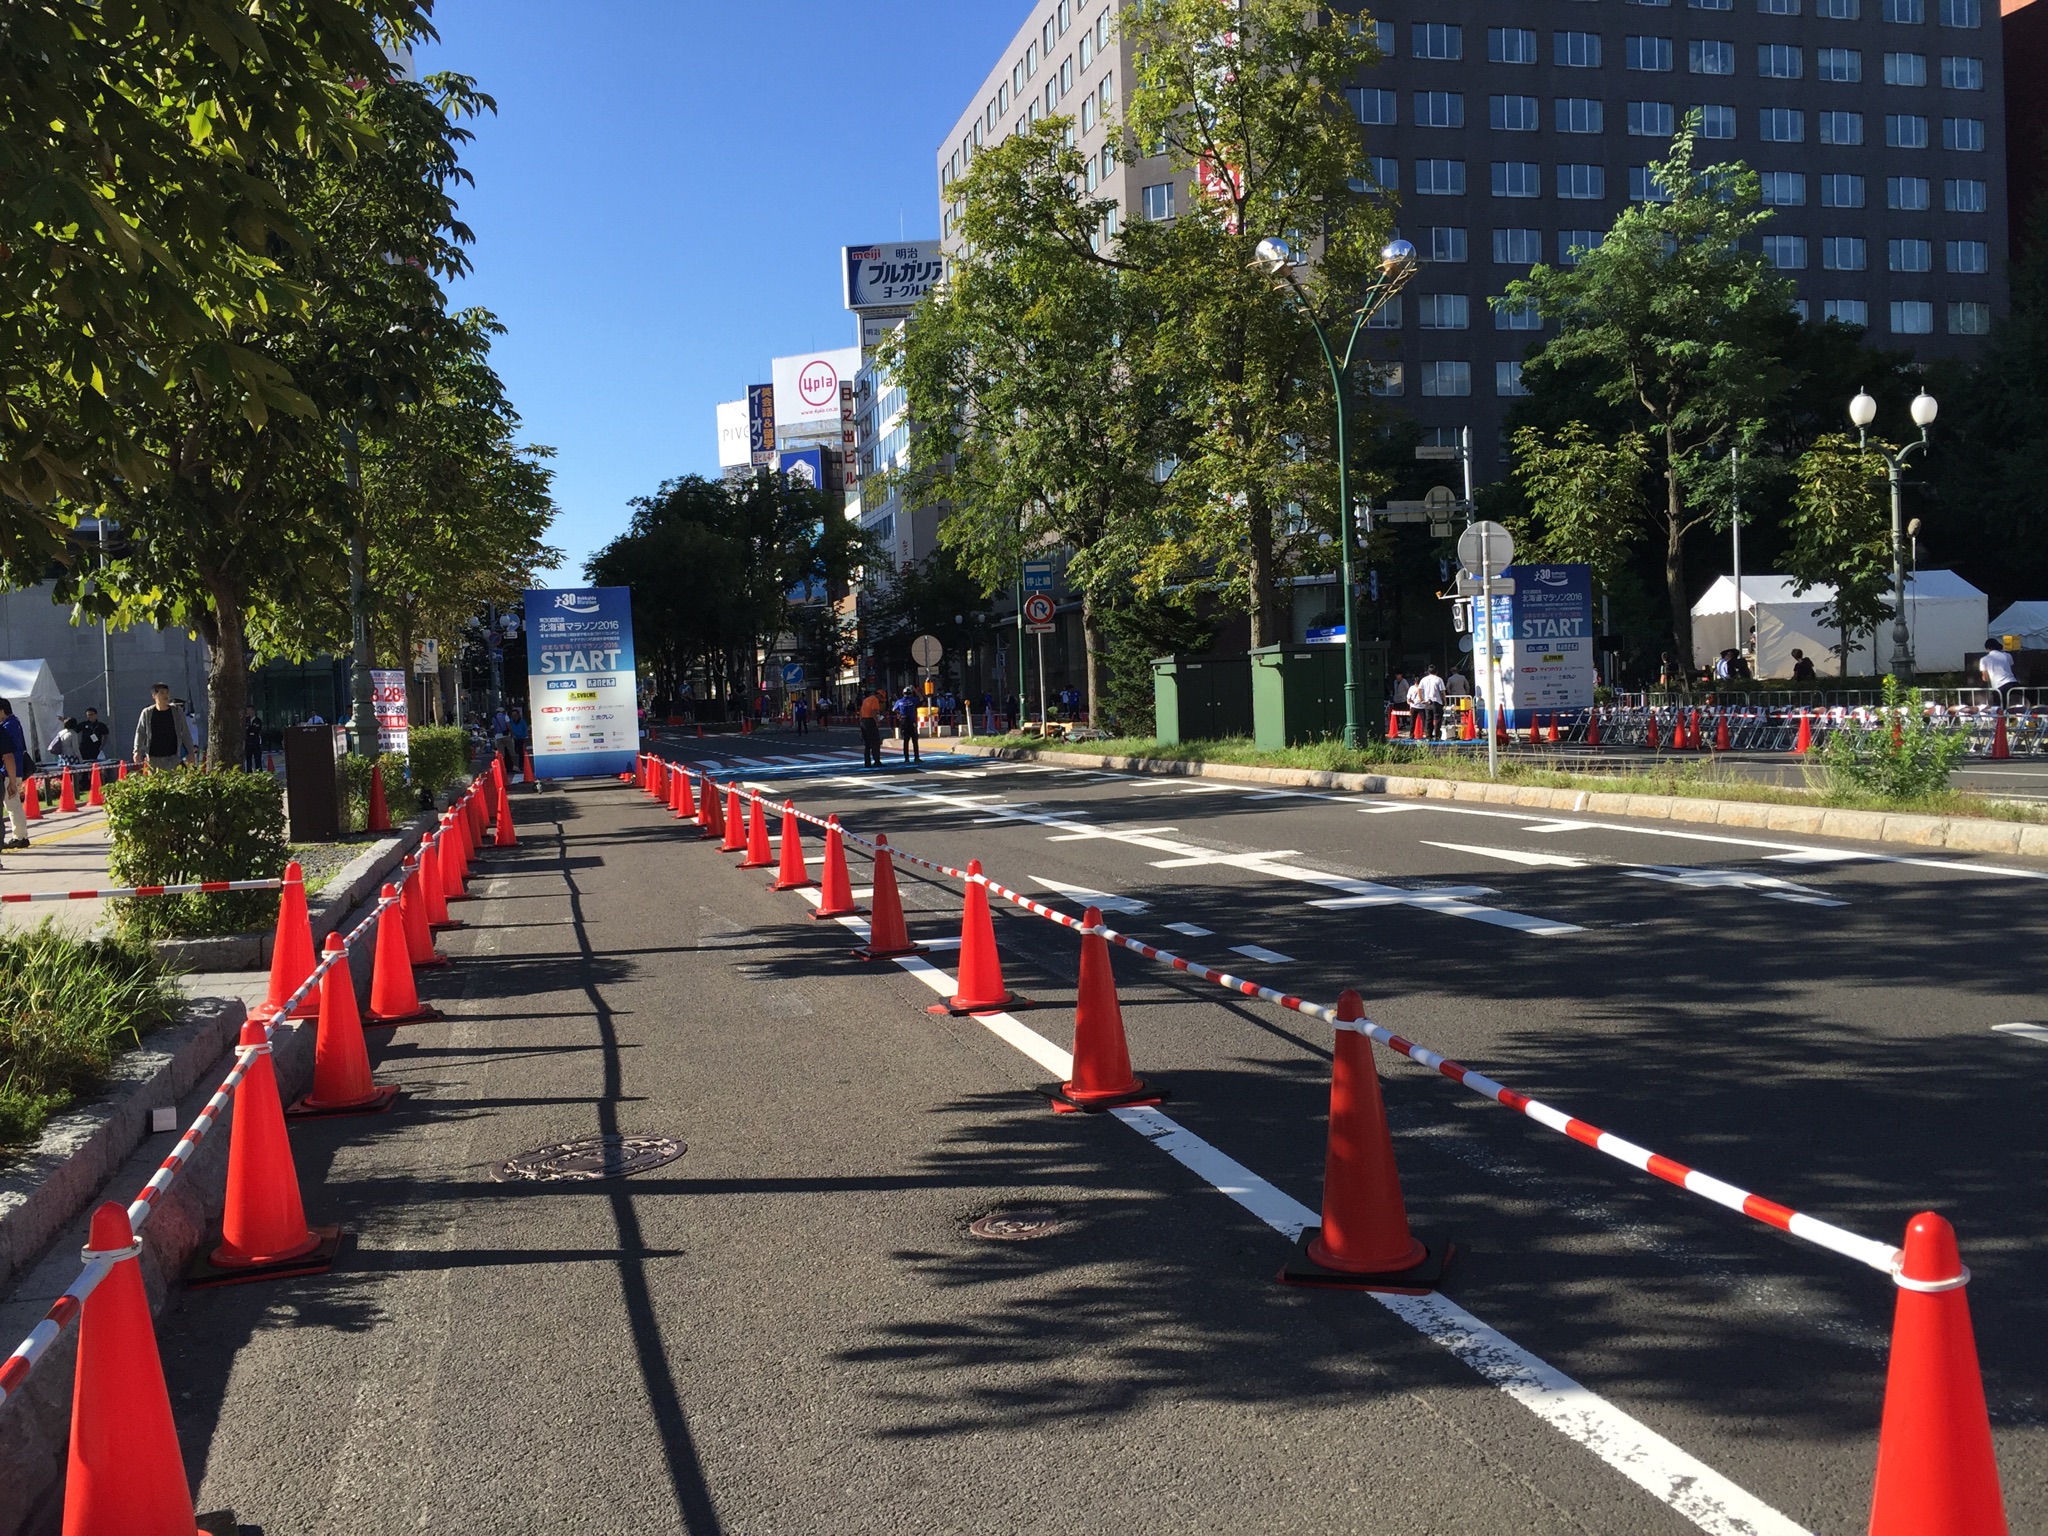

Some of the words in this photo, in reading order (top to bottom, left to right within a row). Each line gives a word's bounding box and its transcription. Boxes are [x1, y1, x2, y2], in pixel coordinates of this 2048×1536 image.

[853, 249, 881, 260] meiji
[895, 248, 918, 259] 明治
[868, 261, 942, 285] ブルガリア
[803, 376, 833, 393] 4pla
[750, 388, 763, 450] イーオン
[761, 387, 775, 450] 英会話&留学
[841, 387, 856, 485] 日之出ビル
[1026, 576, 1051, 587] 停止線
[1540, 569, 1550, 579] 30
[561, 593, 576, 606] 30
[1522, 593, 1582, 602] 北海道マラソン2016
[539, 621, 619, 631] 北海道マラソン2016
[1522, 618, 1584, 638] START
[540, 649, 622, 674] START
